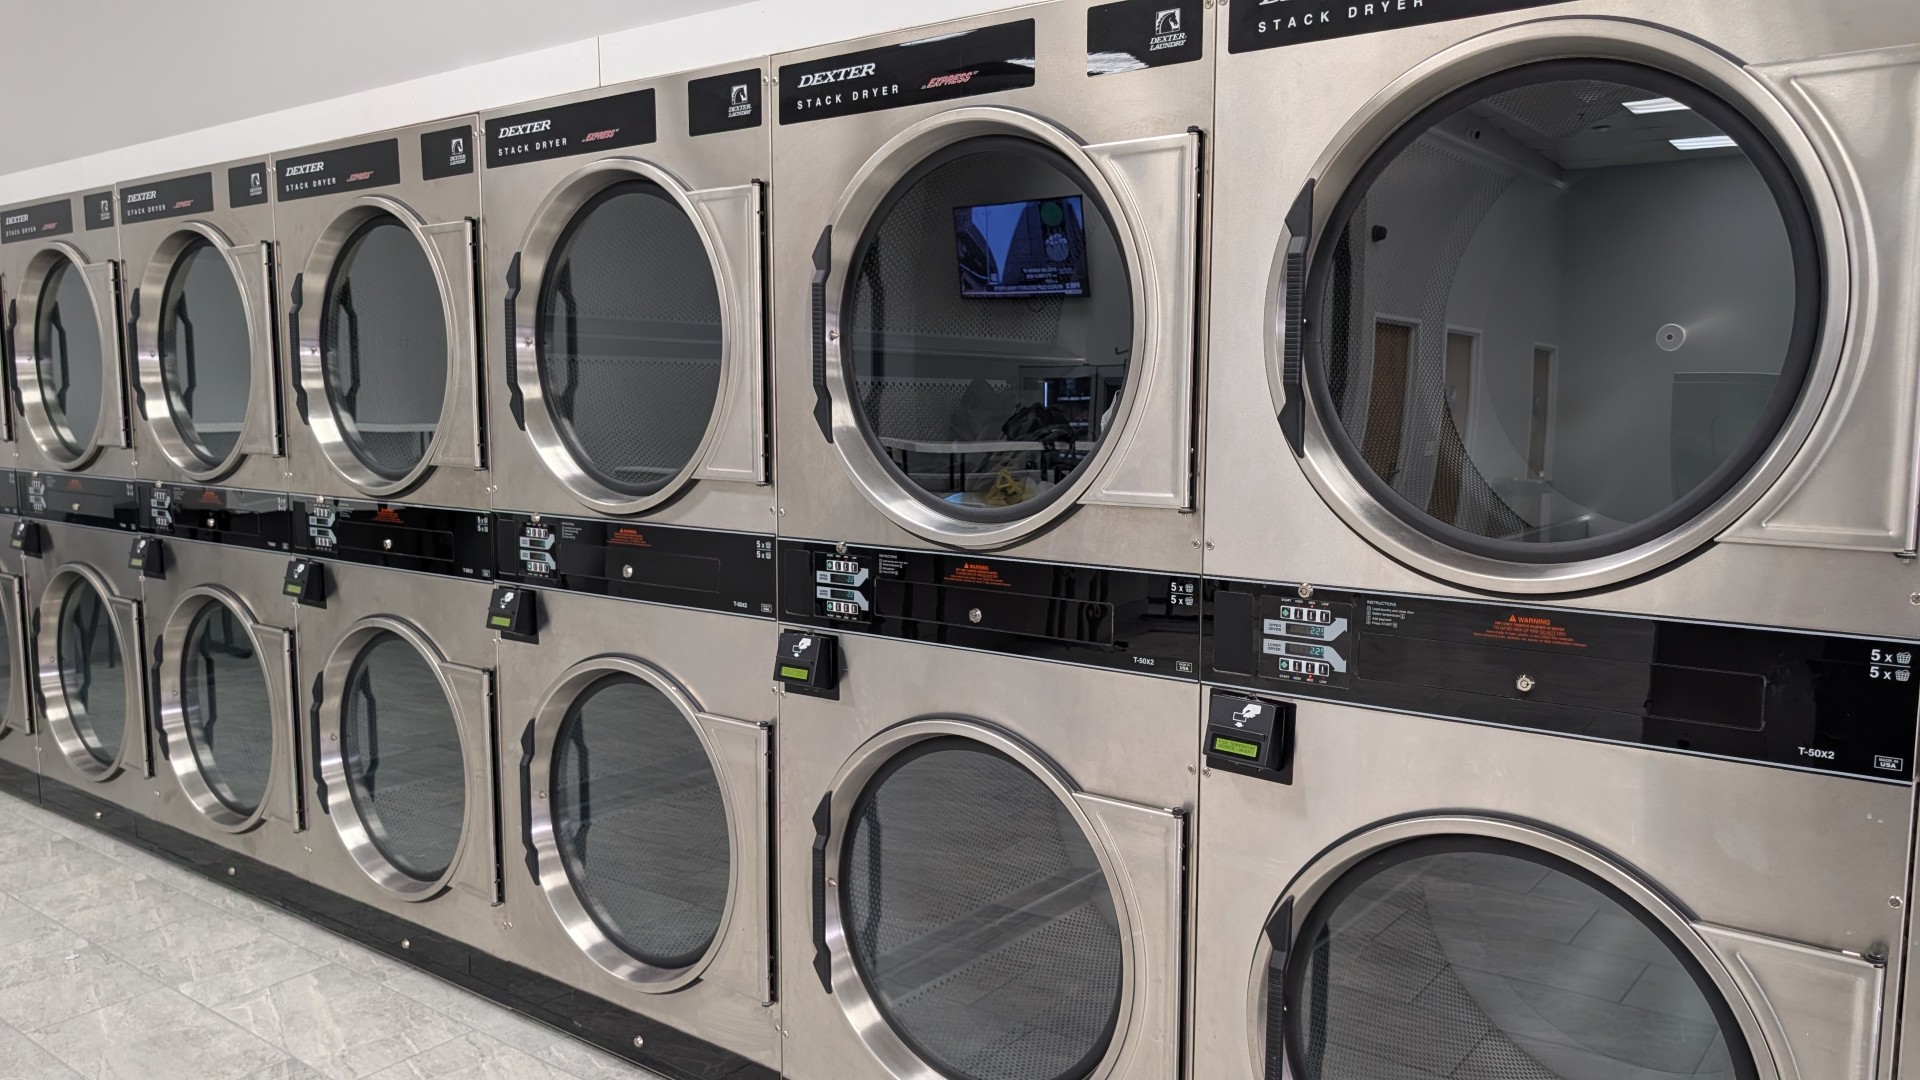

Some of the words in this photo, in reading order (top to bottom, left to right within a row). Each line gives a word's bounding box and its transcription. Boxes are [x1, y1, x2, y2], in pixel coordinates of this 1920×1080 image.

[1258, 11, 1330, 33] STACK
[1348, 0, 1423, 18] DRYER
[1150, 33, 1185, 44] DEXTER
[1150, 40, 1186, 51] LAUNDRY
[798, 63, 876, 88] DEXTER
[927, 72, 973, 88] EXPRESS
[797, 94, 842, 110] STACK
[852, 85, 899, 100] DRYER
[498, 120, 551, 139] DEXTER
[498, 144, 529, 156] STACK
[535, 138, 567, 150] DRYER
[286, 161, 324, 176] DEXTER
[286, 181, 309, 192] STACK
[312, 177, 336, 188] DRYER
[127, 190, 157, 203] DEXTER
[127, 207, 146, 216] STACK
[147, 204, 166, 213] DRYER
[5, 214, 29, 225] DEXTER
[1171, 582, 1177, 592] 5
[1171, 595, 1177, 604] 5
[1518, 617, 1551, 626] WARNING
[1133, 656, 1155, 665] T-50X2
[1871, 649, 1881, 661] 5
[1885, 653, 1893, 663] x
[1869, 666, 1879, 679] 5
[1883, 671, 1891, 680] x
[1798, 746, 1835, 760] T-50X2
